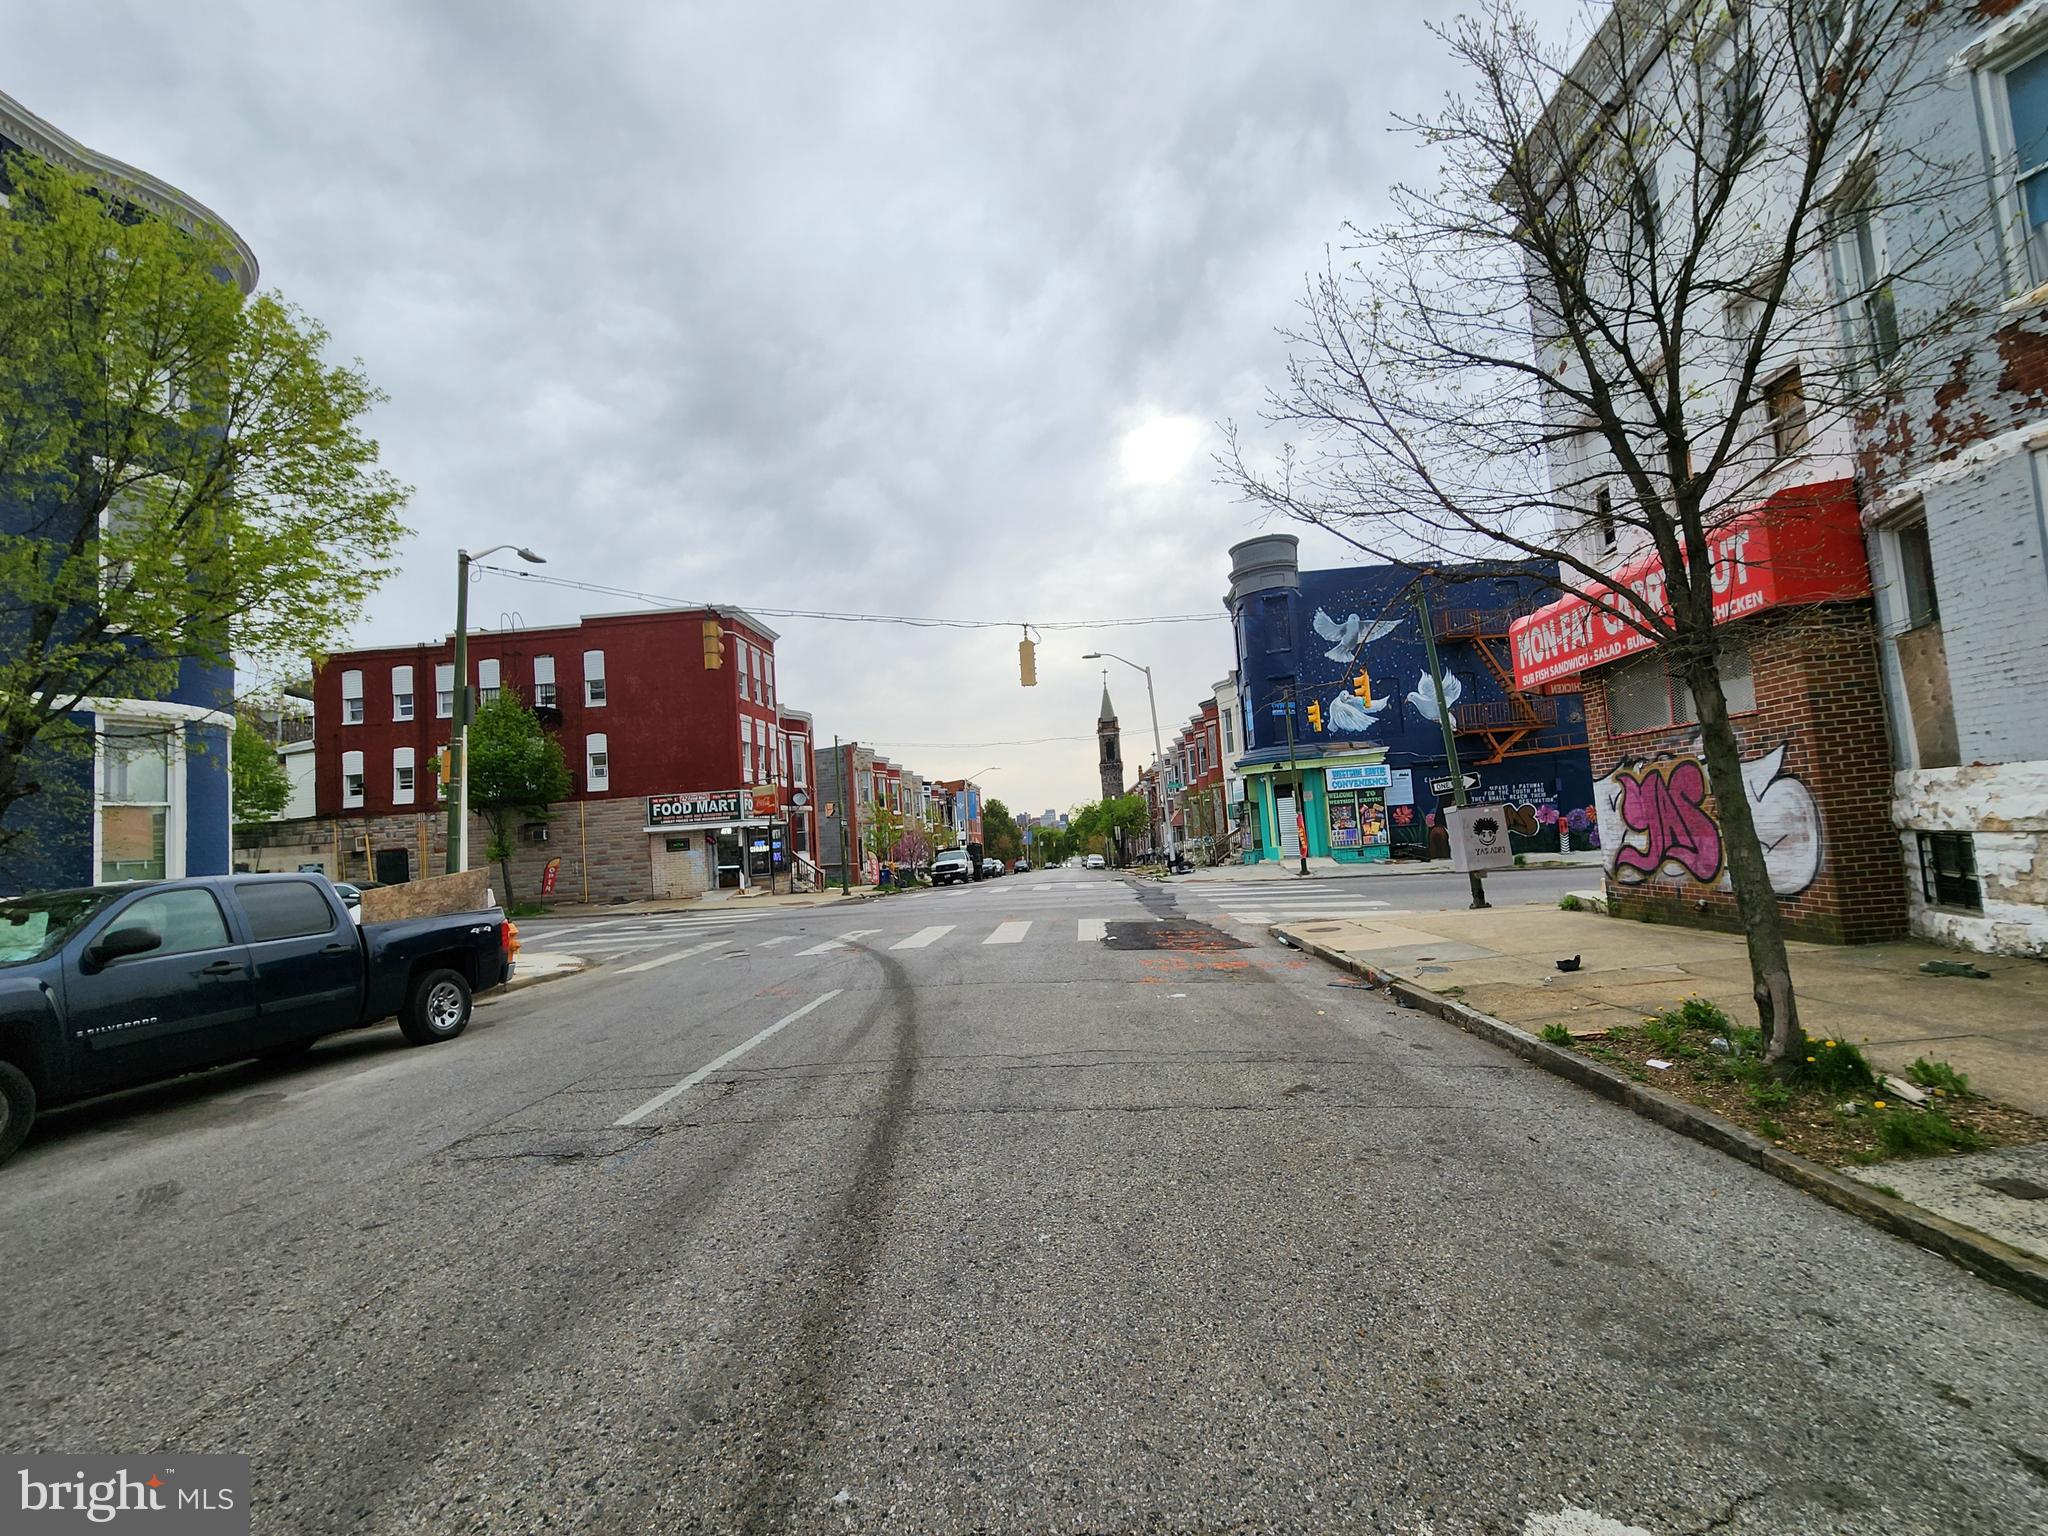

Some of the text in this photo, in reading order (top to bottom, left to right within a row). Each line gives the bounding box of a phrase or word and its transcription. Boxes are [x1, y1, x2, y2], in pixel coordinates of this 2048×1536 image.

[1707, 530, 1749, 594] UT
[1522, 673, 1535, 687] SUB
[1535, 668, 1549, 683] FISH
[1549, 654, 1589, 679] SANDWICH
[1593, 641, 1621, 662] SALAD
[1331, 777, 1389, 789] CONVENIENCE
[1436, 782, 1450, 790] ONE
[652, 802, 692, 817] FOOD
[696, 798, 737, 814] MART
[86, 1017, 158, 1035] SILVERADO
